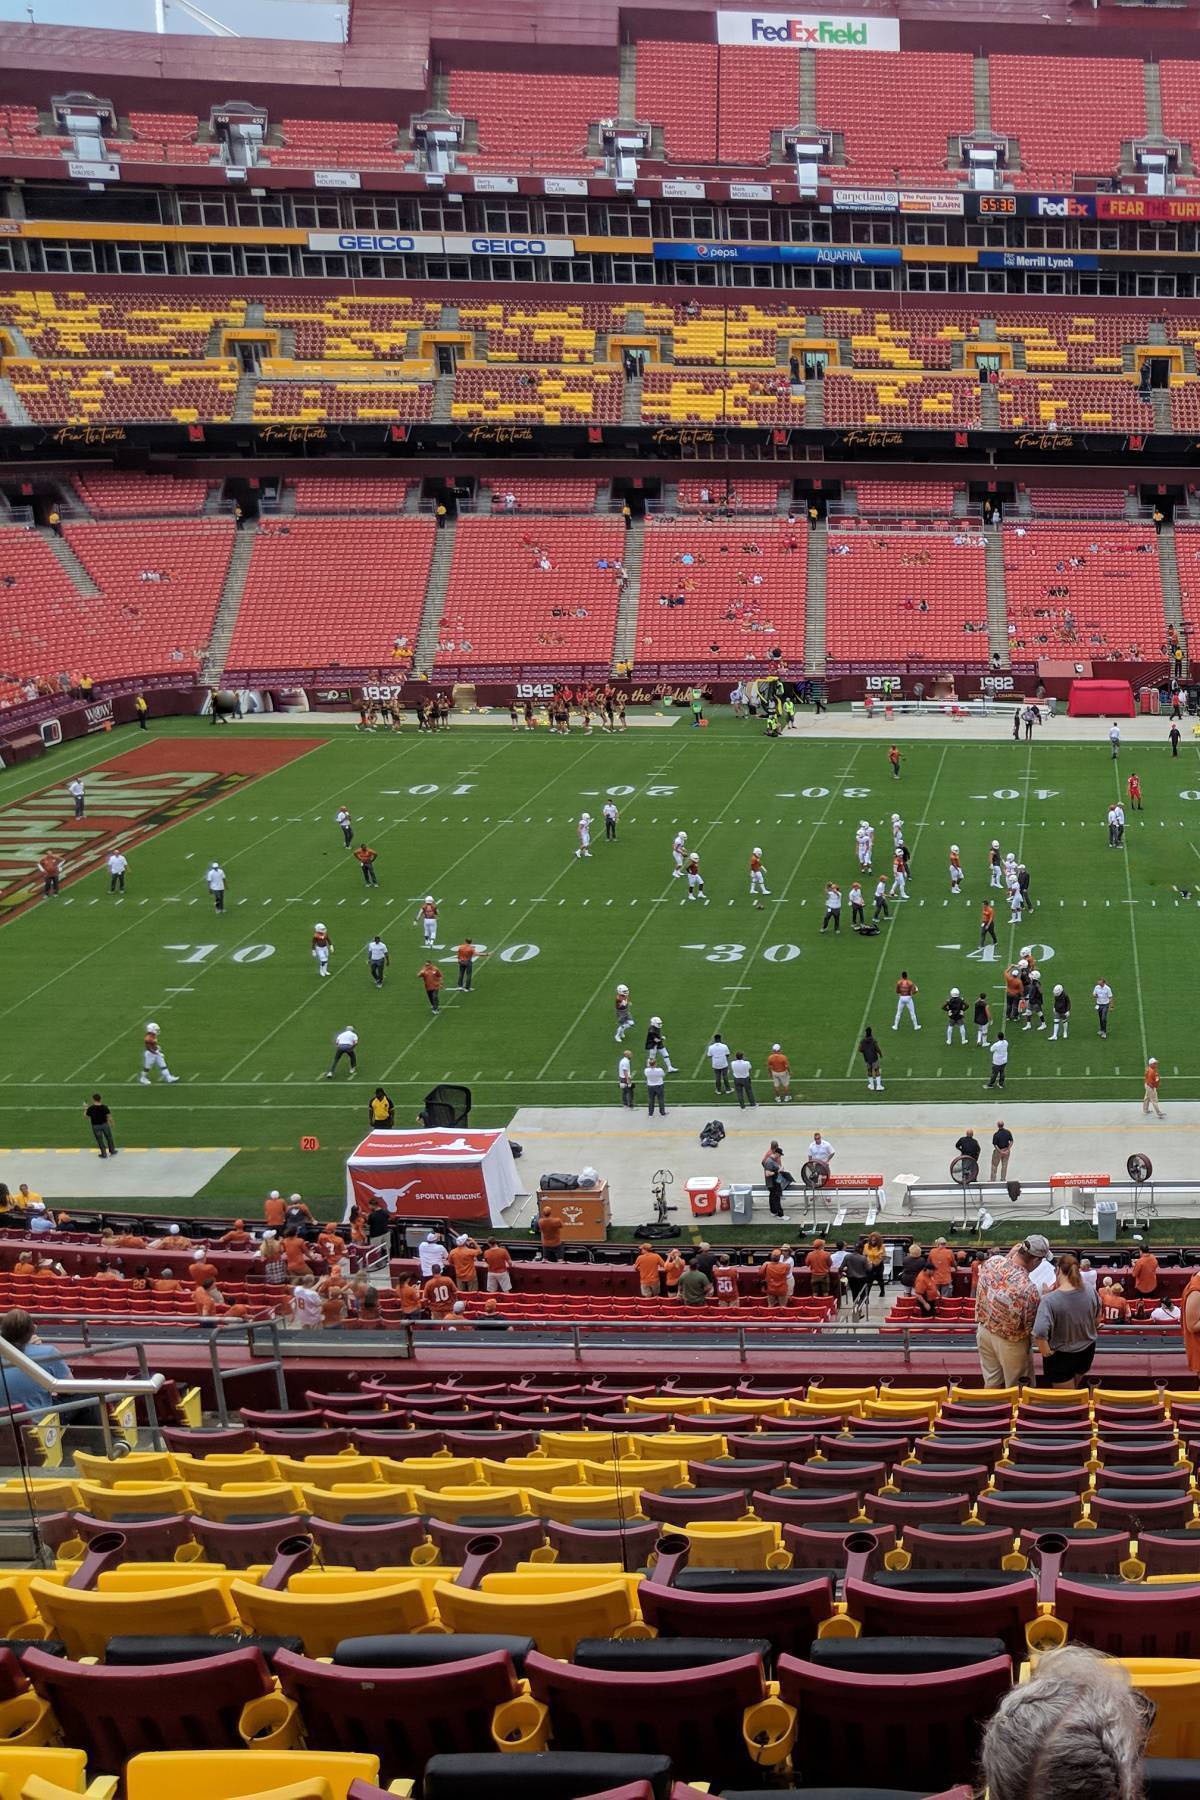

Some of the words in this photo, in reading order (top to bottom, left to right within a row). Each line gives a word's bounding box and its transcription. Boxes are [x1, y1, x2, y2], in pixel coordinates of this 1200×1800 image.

[751, 18, 868, 45] FedExField
[836, 191, 887, 203] Carpetland
[932, 201, 960, 209] LEARN
[1038, 198, 1088, 216] FedEx
[338, 235, 415, 250] GEICO
[471, 239, 546, 254] GEICO
[710, 248, 738, 258] pepsi
[817, 249, 864, 264] AQUAFINA
[1016, 255, 1045, 266] Merrill
[1048, 256, 1074, 268] Lynch
[979, 676, 1014, 690] 1982
[516, 684, 555, 698] 1942
[617, 689, 628, 701] to
[631, 688, 651, 702] the
[176, 944, 277, 964] 10
[701, 942, 803, 963] 30
[304, 1138, 316, 1149] 20
[1064, 1178, 1098, 1186] GATORADE
[415, 1192, 444, 1201] SPORTS
[446, 1192, 482, 1201] MEDICINE
[694, 1194, 709, 1208] G
[132, 1279, 146, 1290] 28
[717, 1280, 733, 1293] 20
[435, 1286, 449, 1302] 10
[1105, 1306, 1120, 1320] 10
